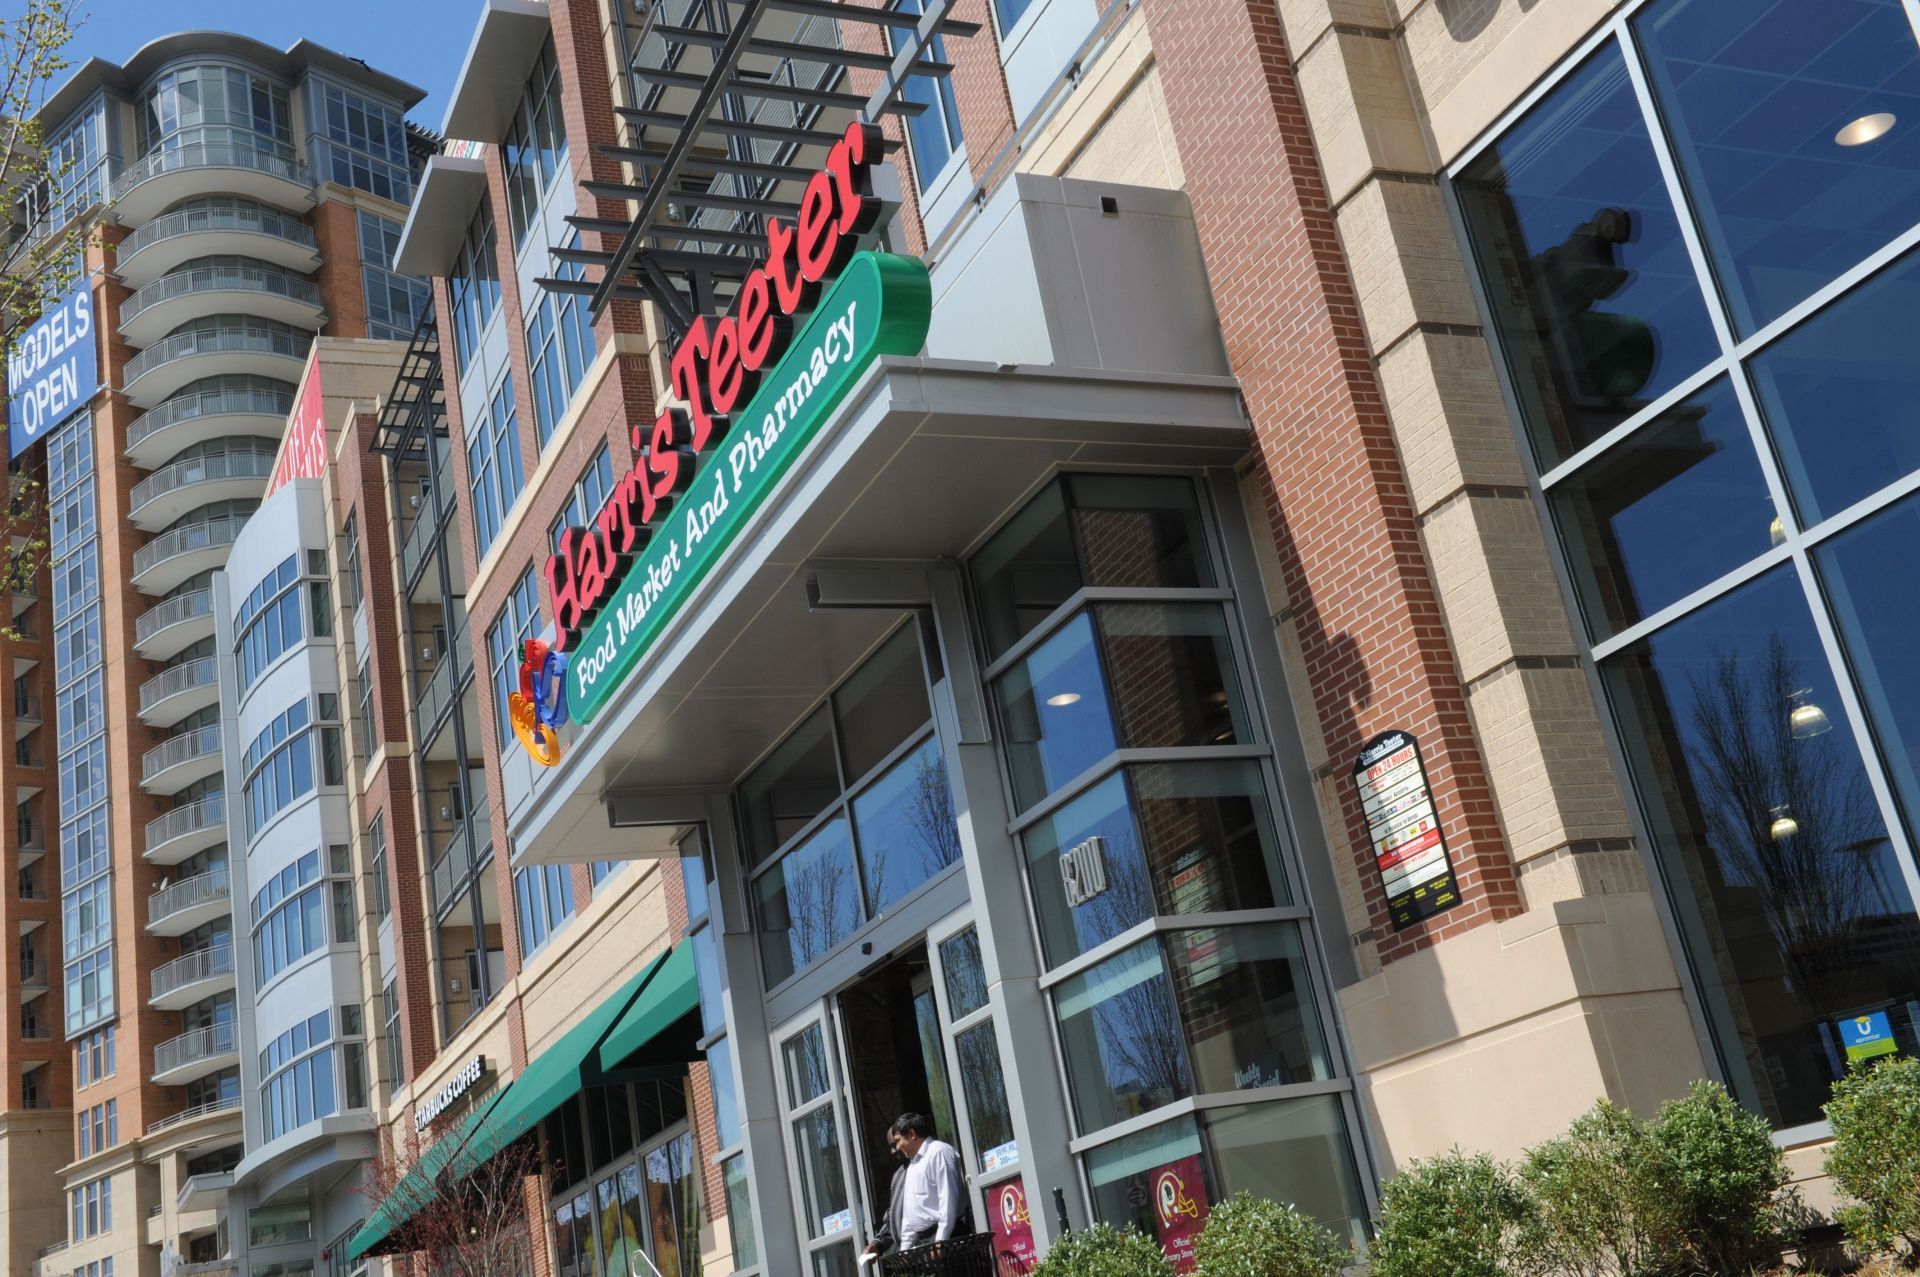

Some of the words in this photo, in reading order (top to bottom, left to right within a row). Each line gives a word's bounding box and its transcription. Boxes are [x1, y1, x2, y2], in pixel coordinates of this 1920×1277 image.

[8, 292, 90, 394] MODELS
[22, 355, 78, 436] OPEN
[543, 407, 680, 653] Harris
[671, 121, 864, 455] Teeter
[576, 621, 617, 699] Food
[616, 539, 681, 647] Market
[684, 468, 730, 558] And
[728, 300, 857, 494] Pharmacy
[1367, 764, 1383, 781] OPEN
[1382, 760, 1392, 771] 24
[1391, 748, 1413, 766] HOURS
[415, 1083, 454, 1133] STARBUCKS
[452, 1056, 481, 1098] COFFEE
[1234, 1062, 1261, 1089] Weekly
[1181, 1248, 1194, 1259] Store
